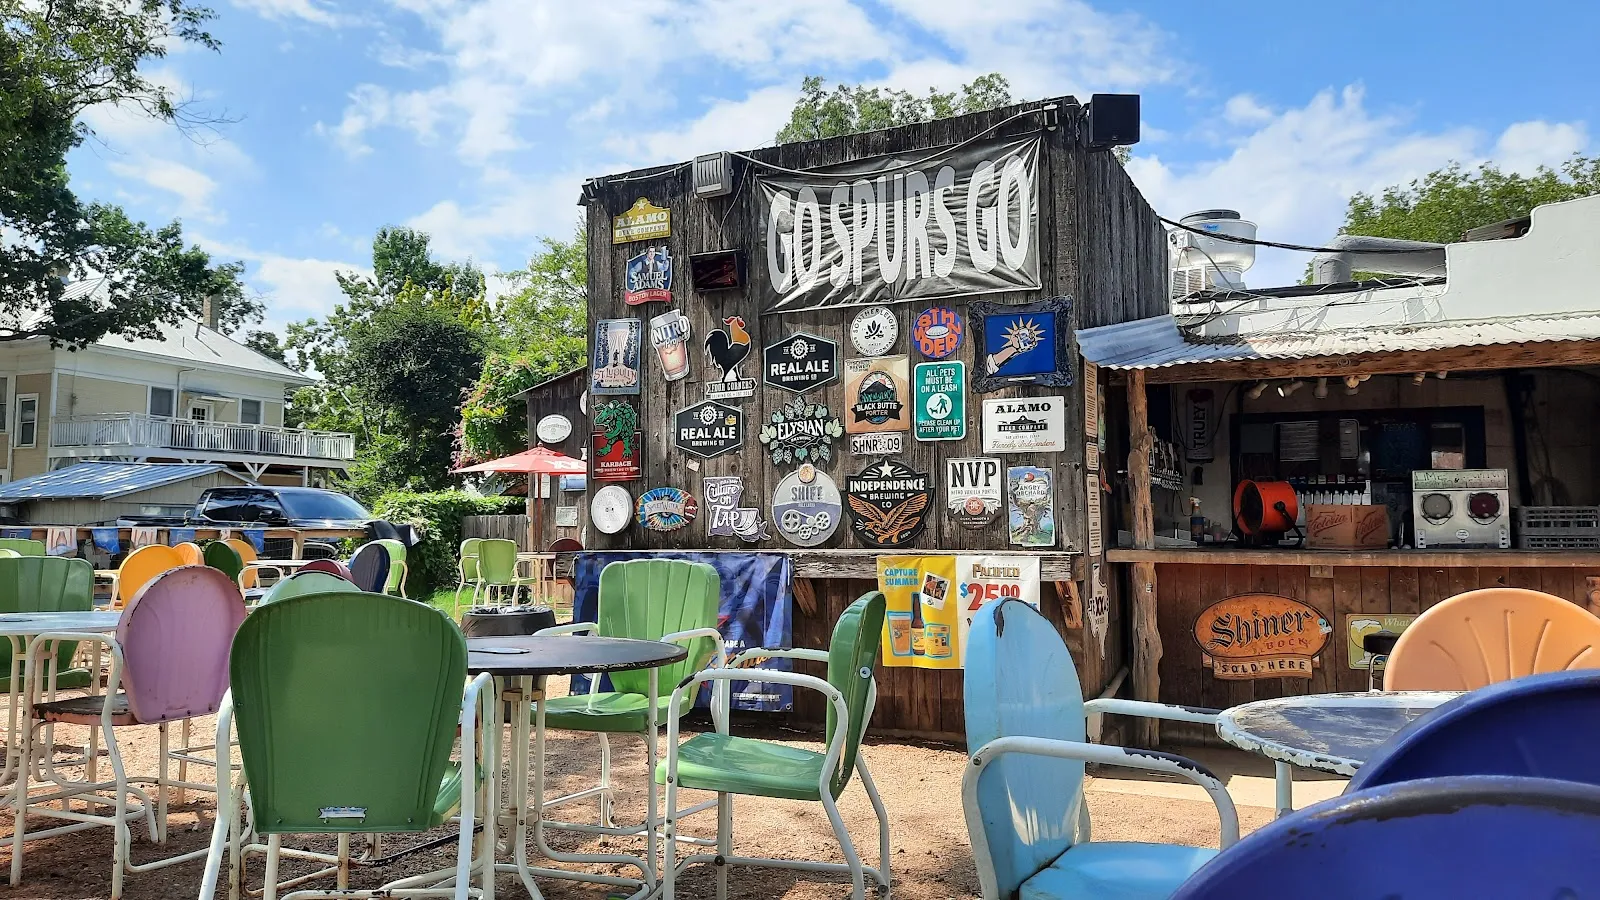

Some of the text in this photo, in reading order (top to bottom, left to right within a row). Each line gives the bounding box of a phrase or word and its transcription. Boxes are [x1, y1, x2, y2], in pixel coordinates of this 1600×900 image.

[616, 211, 668, 228] ALAMO
[766, 155, 1030, 295] GO SPURS GO
[629, 270, 668, 284] SAMUEL
[630, 280, 665, 294] ADAMS
[628, 290, 667, 302] BOSTON LAGER
[853, 308, 896, 334] SOUTHERLEIGH
[653, 317, 688, 345] NITRO
[770, 359, 830, 377] REAL ALE
[926, 367, 956, 378] ALL PETS
[711, 380, 753, 393] FOUR CORNERS
[925, 375, 954, 386] MUST BE
[921, 384, 958, 394] ON A LEASH
[856, 402, 876, 412] BLACK
[995, 402, 1052, 414] ALAMO
[681, 426, 737, 441] REAL ALE
[777, 418, 824, 441] ELYSIAN
[935, 425, 950, 433] YOUR
[950, 425, 961, 433] PET
[852, 439, 879, 453] SHNR
[887, 438, 900, 451] 09
[992, 439, 1056, 449] Fiercely Independent
[950, 461, 997, 488] NVP
[849, 477, 925, 493] INDEPENDENCE
[707, 482, 740, 503] Culture
[869, 492, 905, 500] BREWING
[1016, 489, 1045, 497] ORCHARD
[712, 503, 740, 530] TAP
[885, 568, 918, 577] CAPTURE
[972, 563, 1020, 578] PACIFICO
[885, 578, 919, 586] SUMMER
[1205, 611, 1314, 650] Shiner
[740, 639, 746, 649] A
[1266, 638, 1310, 650] BOCK
[1221, 661, 1305, 675] SOLD HERE
